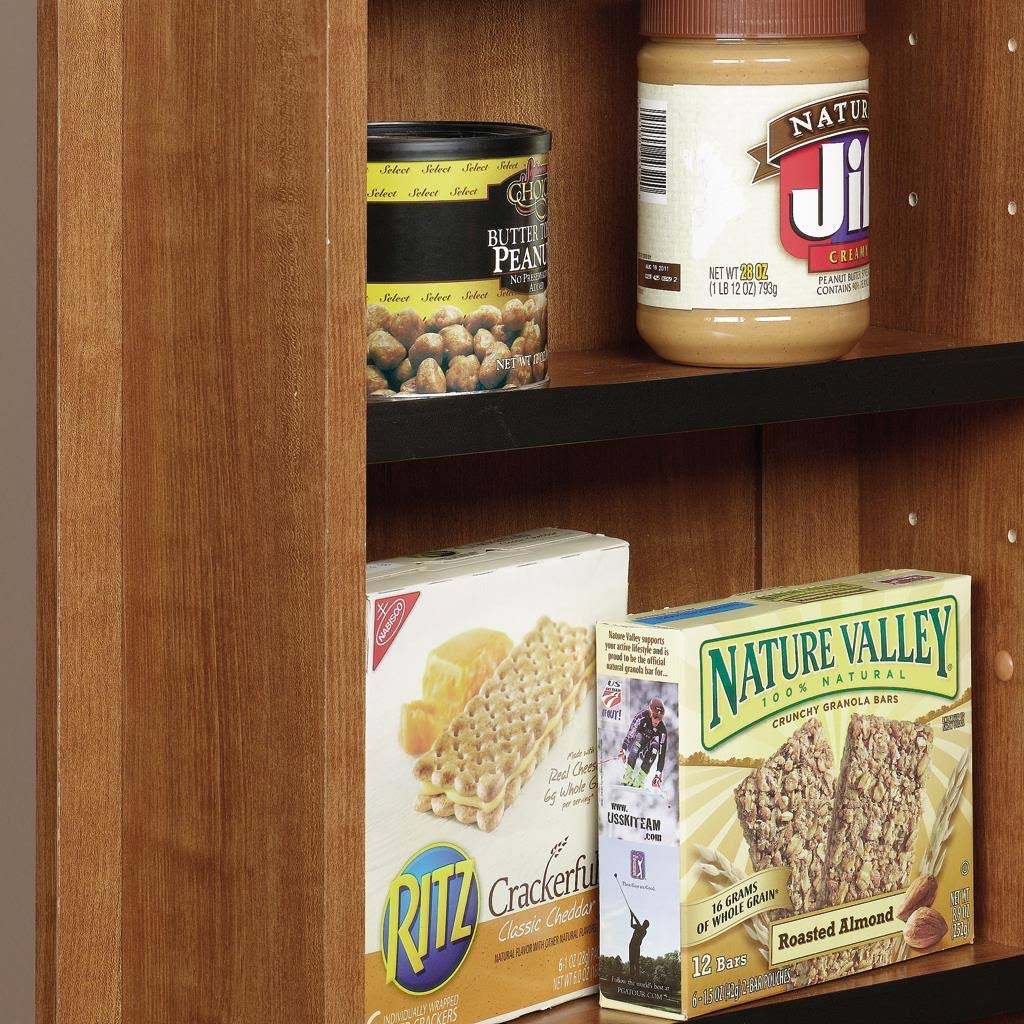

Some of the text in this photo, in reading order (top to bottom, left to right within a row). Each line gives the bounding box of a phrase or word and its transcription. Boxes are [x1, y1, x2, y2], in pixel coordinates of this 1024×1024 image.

[790, 99, 869, 136] NATUR
[379, 161, 489, 176] Select Select Select
[408, 186, 478, 198] Select Select
[488, 225, 539, 247] BUTTER
[493, 245, 547, 273] PEANU
[709, 263, 768, 280] NET 28 OZ
[818, 274, 847, 285] PEANUT
[379, 290, 489, 303] Select Select Select
[816, 285, 852, 296] CONTAINS
[496, 357, 517, 371] NET
[378, 602, 403, 642] NABISCO
[608, 630, 641, 644] Nature Valley
[632, 643, 652, 656] lifestyle
[647, 655, 666, 666] official
[708, 604, 952, 730] NATURE VALLEY
[822, 669, 906, 686] NATURAL
[823, 694, 899, 712] GRANOLA BARS
[611, 802, 628, 813] www.
[607, 812, 661, 831] USSKITEAM
[644, 832, 662, 842] .com
[488, 848, 599, 918] Crackerful
[711, 881, 758, 914] 16 GRAMS
[386, 858, 475, 985] RITZ
[498, 896, 596, 942] Classic Cheddar
[696, 921, 710, 935] OF
[778, 906, 894, 950] Roasted Almond
[692, 952, 748, 978] 12 Bars
